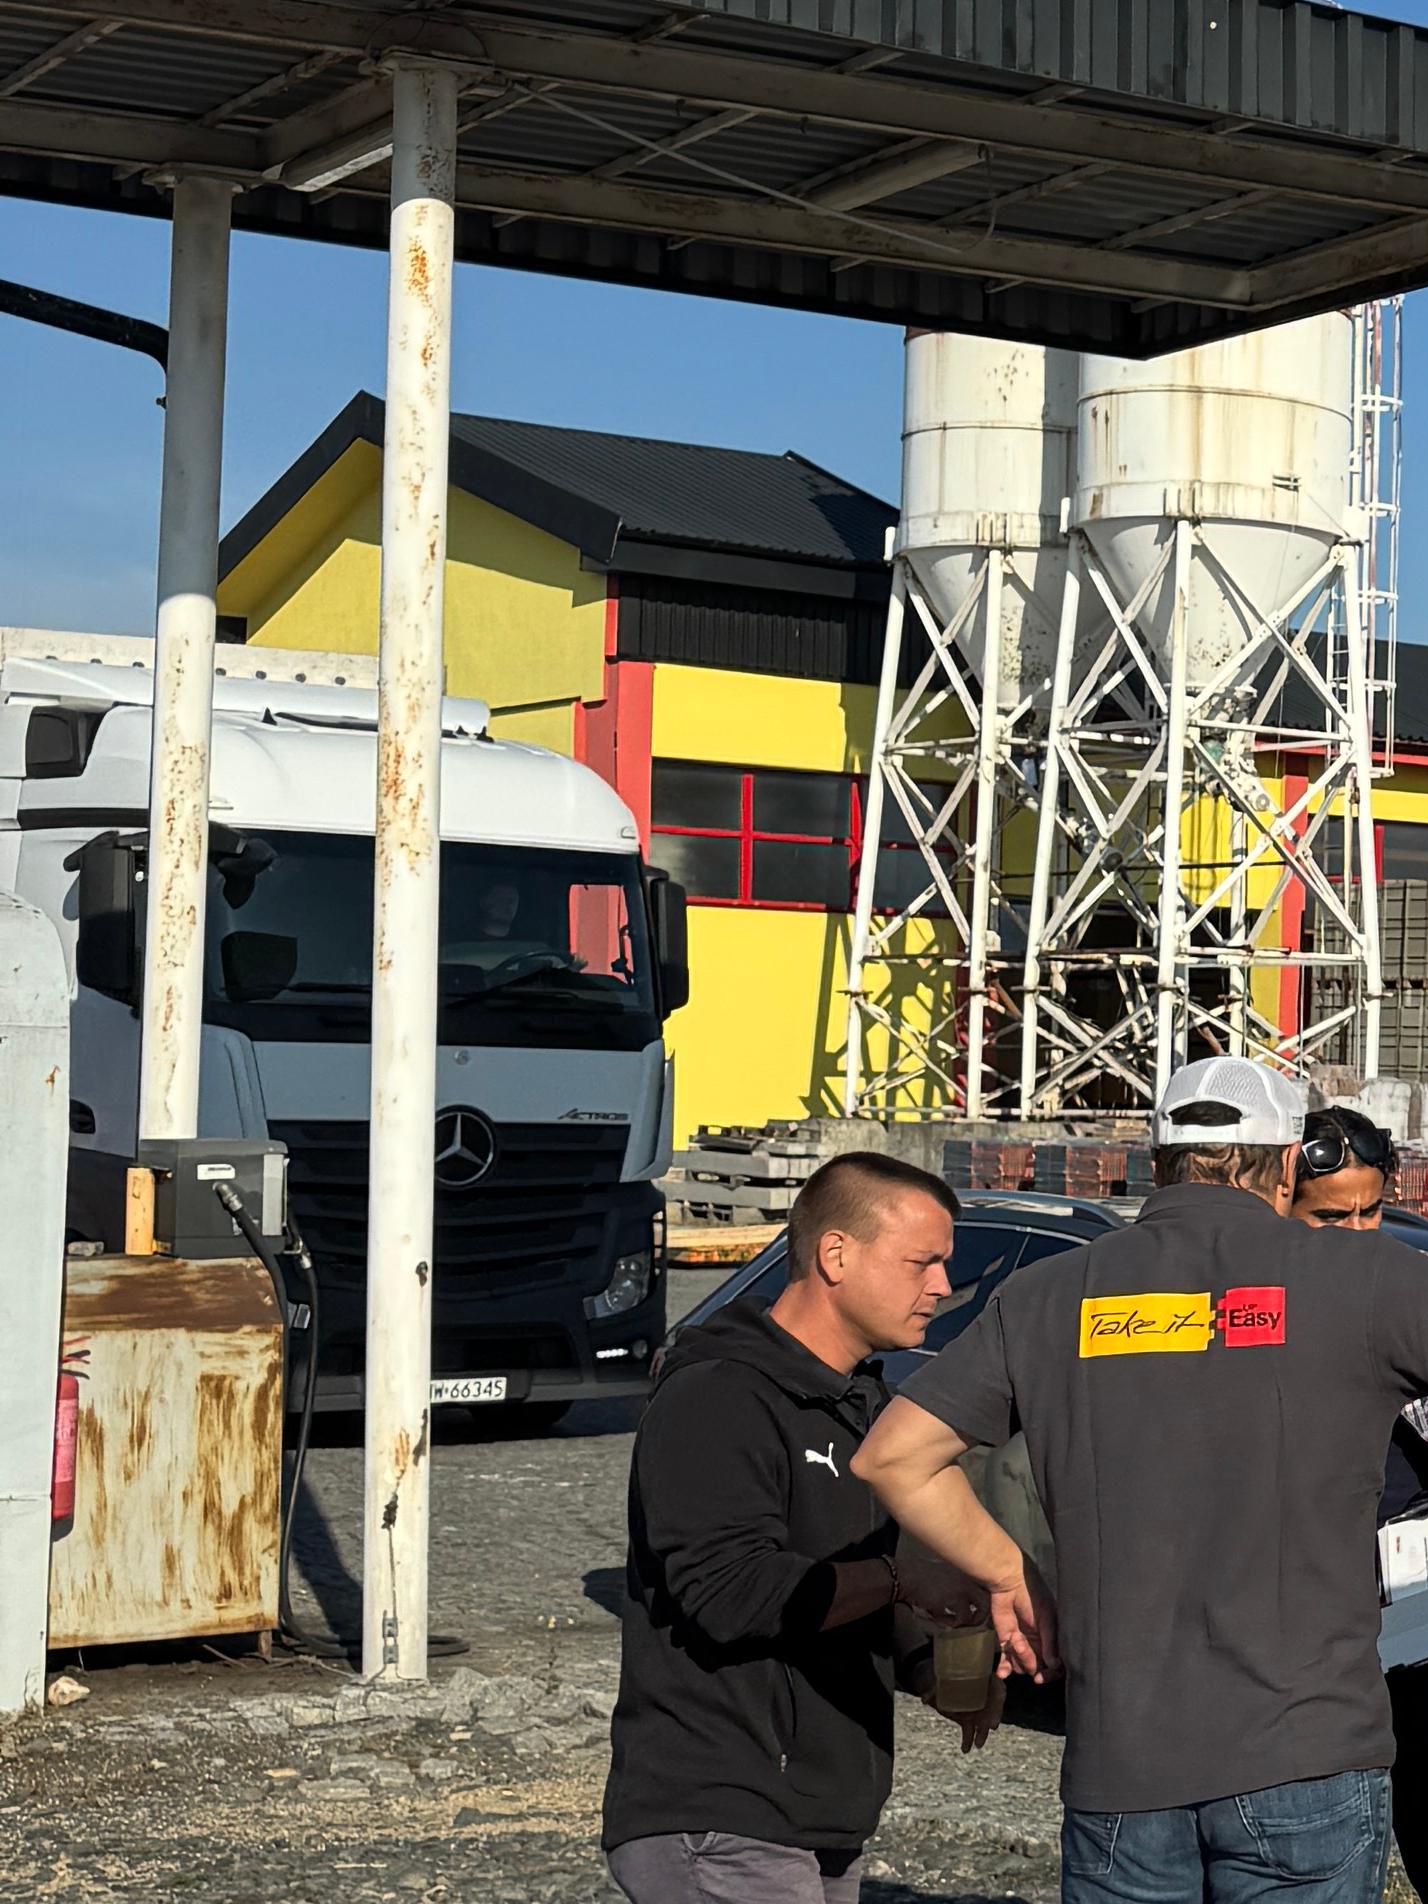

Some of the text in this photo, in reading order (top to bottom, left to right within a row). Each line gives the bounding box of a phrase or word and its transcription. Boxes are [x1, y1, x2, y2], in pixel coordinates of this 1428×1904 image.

[1091, 1310, 1158, 1339] Take
[1229, 1308, 1282, 1330] Easy
[450, 1379, 504, 1399] 66345
